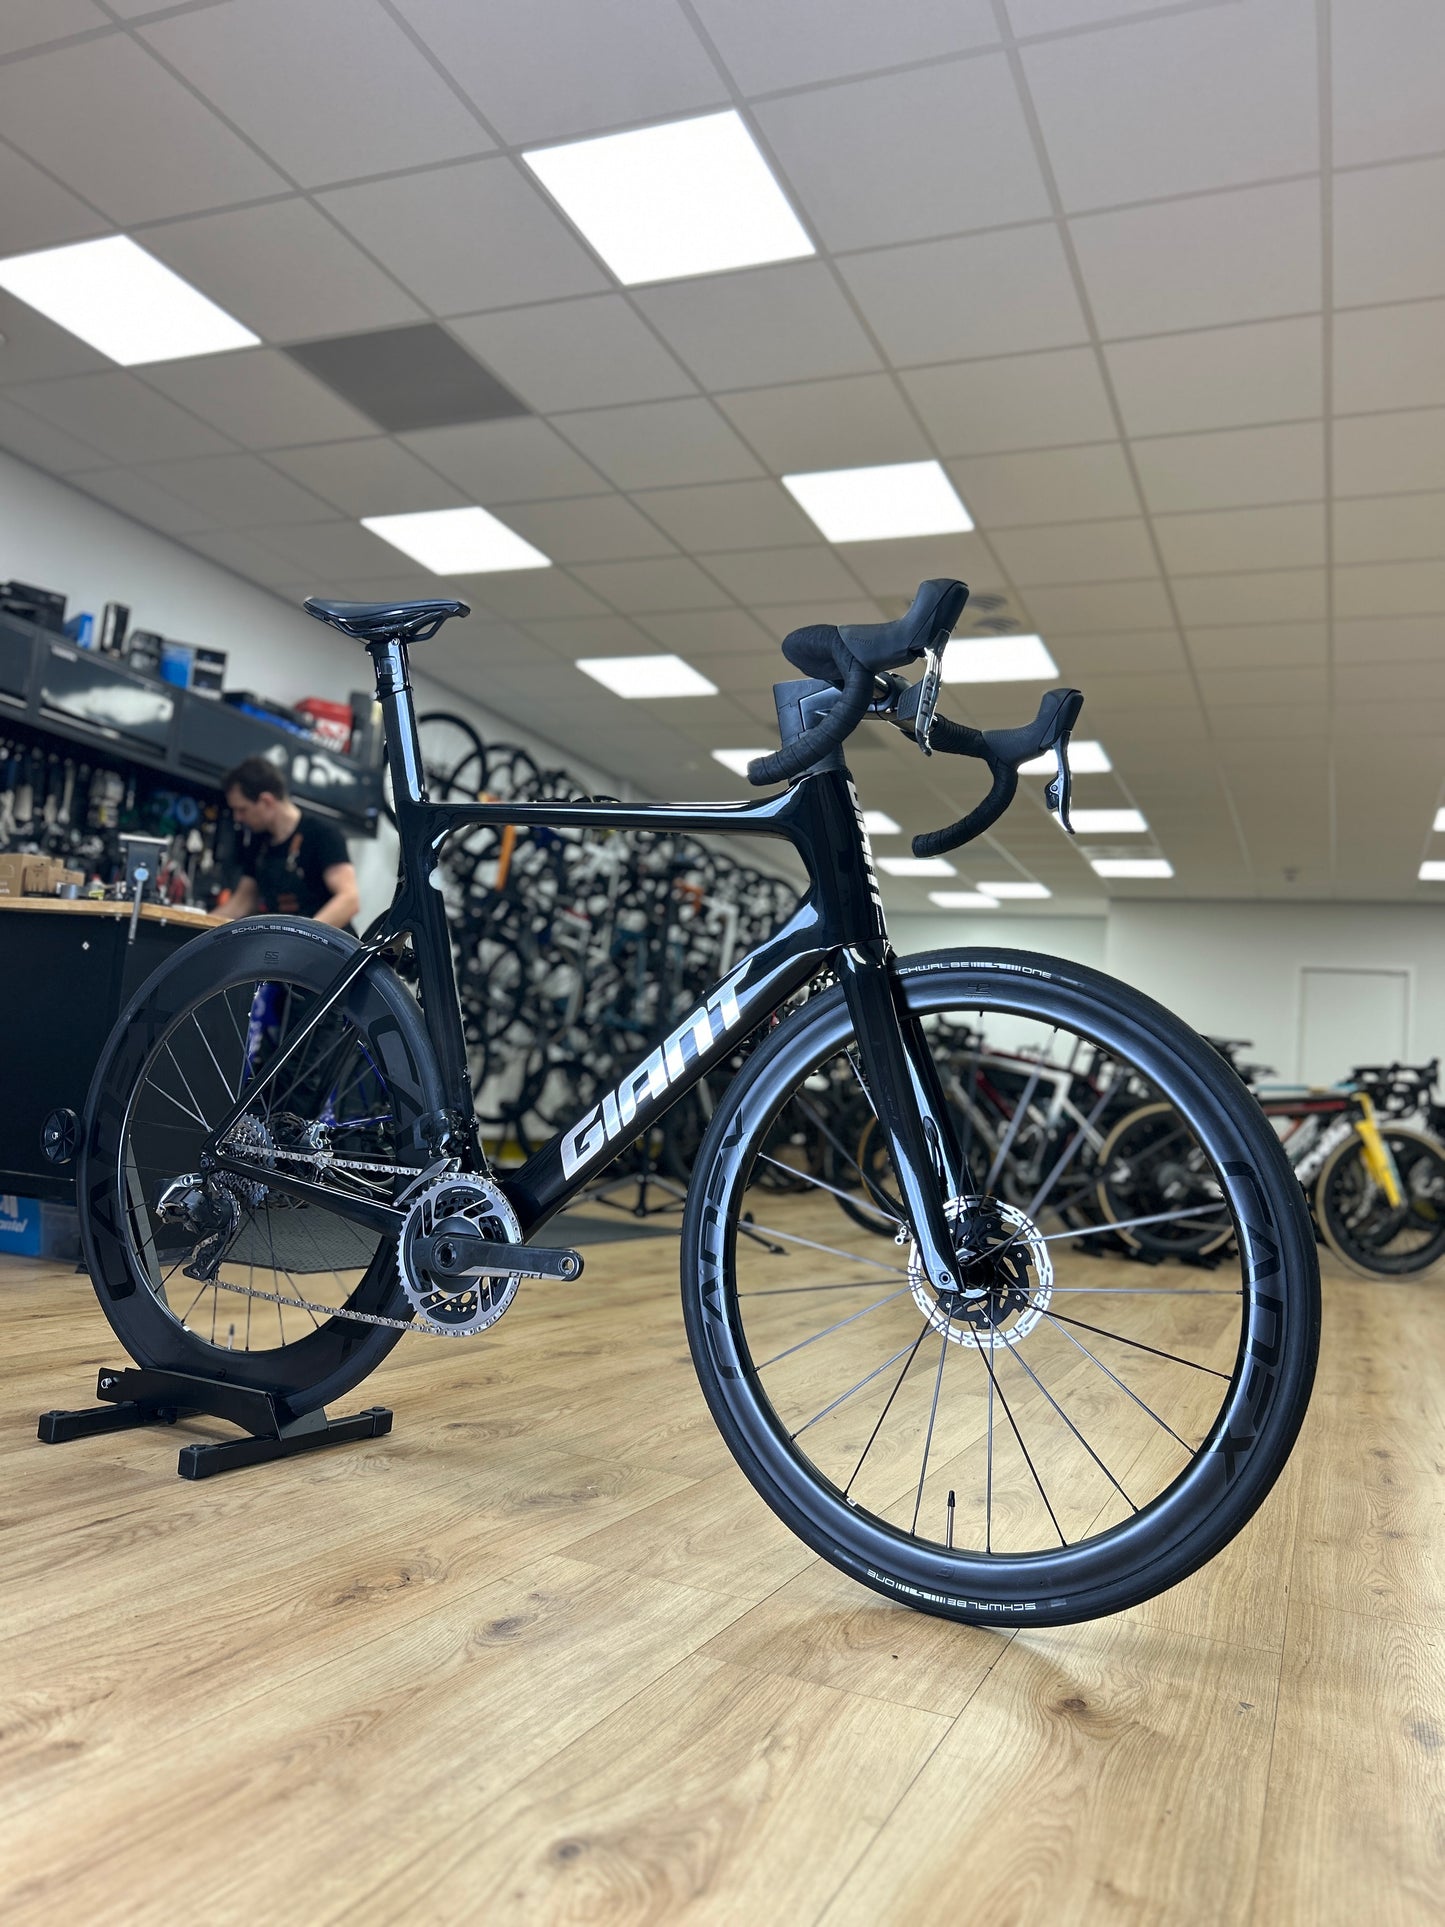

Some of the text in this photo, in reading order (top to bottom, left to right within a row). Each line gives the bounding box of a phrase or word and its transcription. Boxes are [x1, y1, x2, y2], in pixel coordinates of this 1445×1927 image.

[232, 924, 282, 935] SCHWALBE
[896, 961, 1052, 979] CHWALBE ONE
[561, 958, 753, 1181] GIANT
[700, 1107, 751, 1379] CADEX
[1207, 1161, 1284, 1486] CADEX
[866, 1568, 1037, 1612] SCHWALBE ONE
